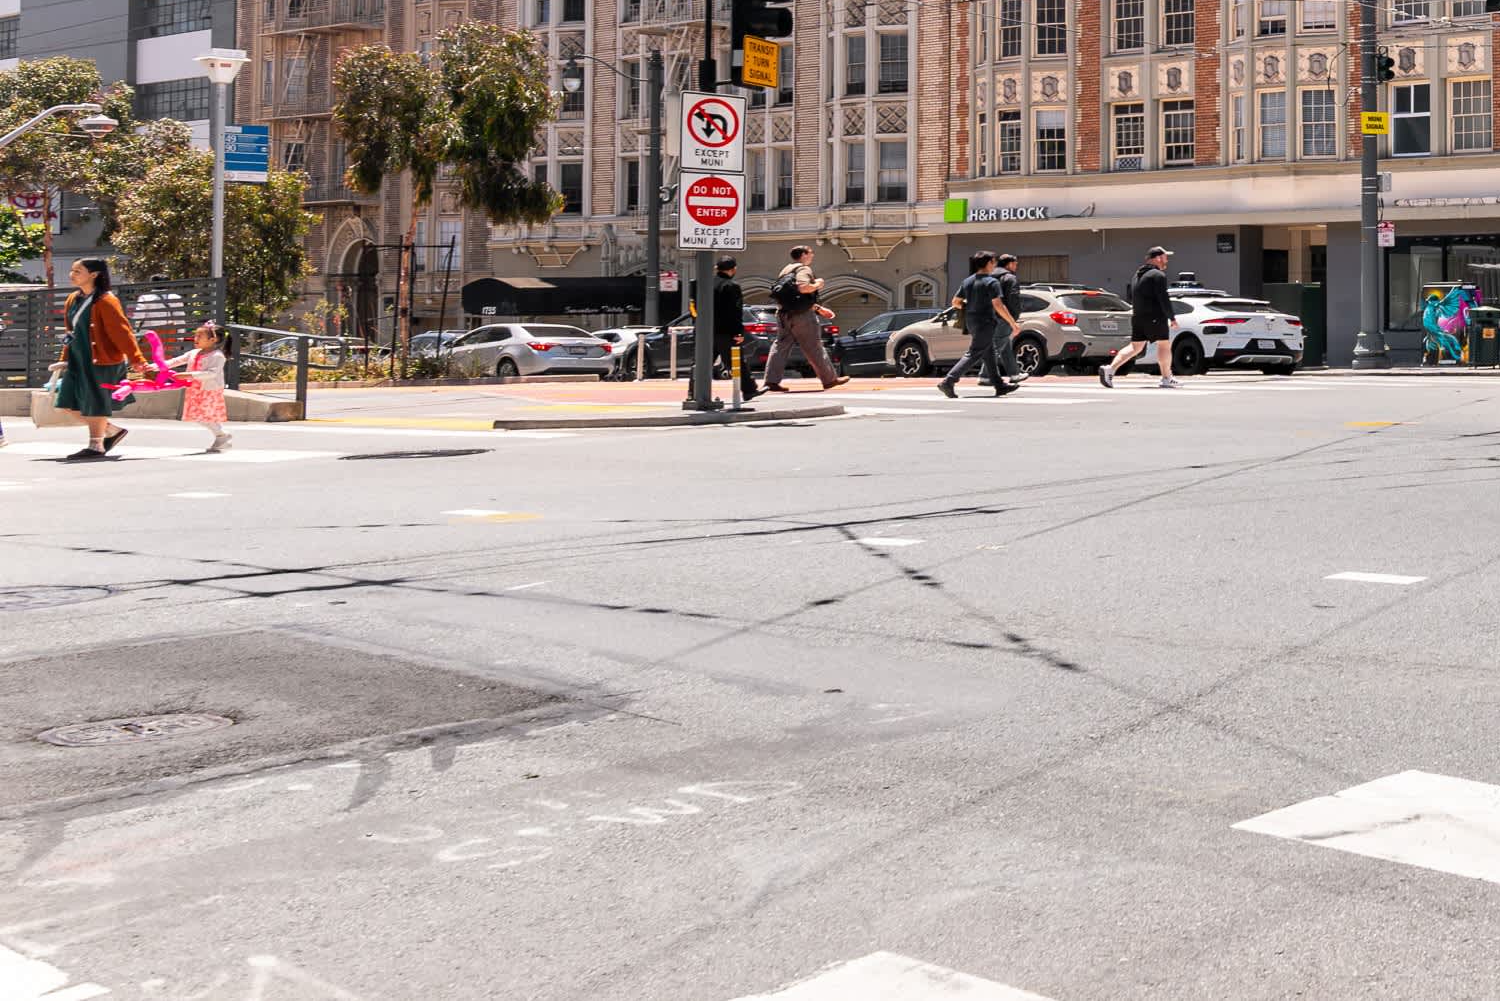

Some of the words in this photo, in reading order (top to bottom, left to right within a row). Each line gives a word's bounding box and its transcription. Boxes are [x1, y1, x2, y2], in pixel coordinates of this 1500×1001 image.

[749, 41, 775, 55] TRANSIT
[753, 56, 770, 68] TURN
[749, 68, 773, 82] SIGNAL
[695, 149, 729, 158] EXCEPT
[693, 186, 707, 194] DO
[712, 187, 731, 195] NOT
[696, 208, 728, 217] ENTER
[969, 208, 997, 221] H&R
[1001, 206, 1046, 220] BLOCK
[694, 228, 731, 236] EXCEPT
[683, 237, 706, 245] MUNI
